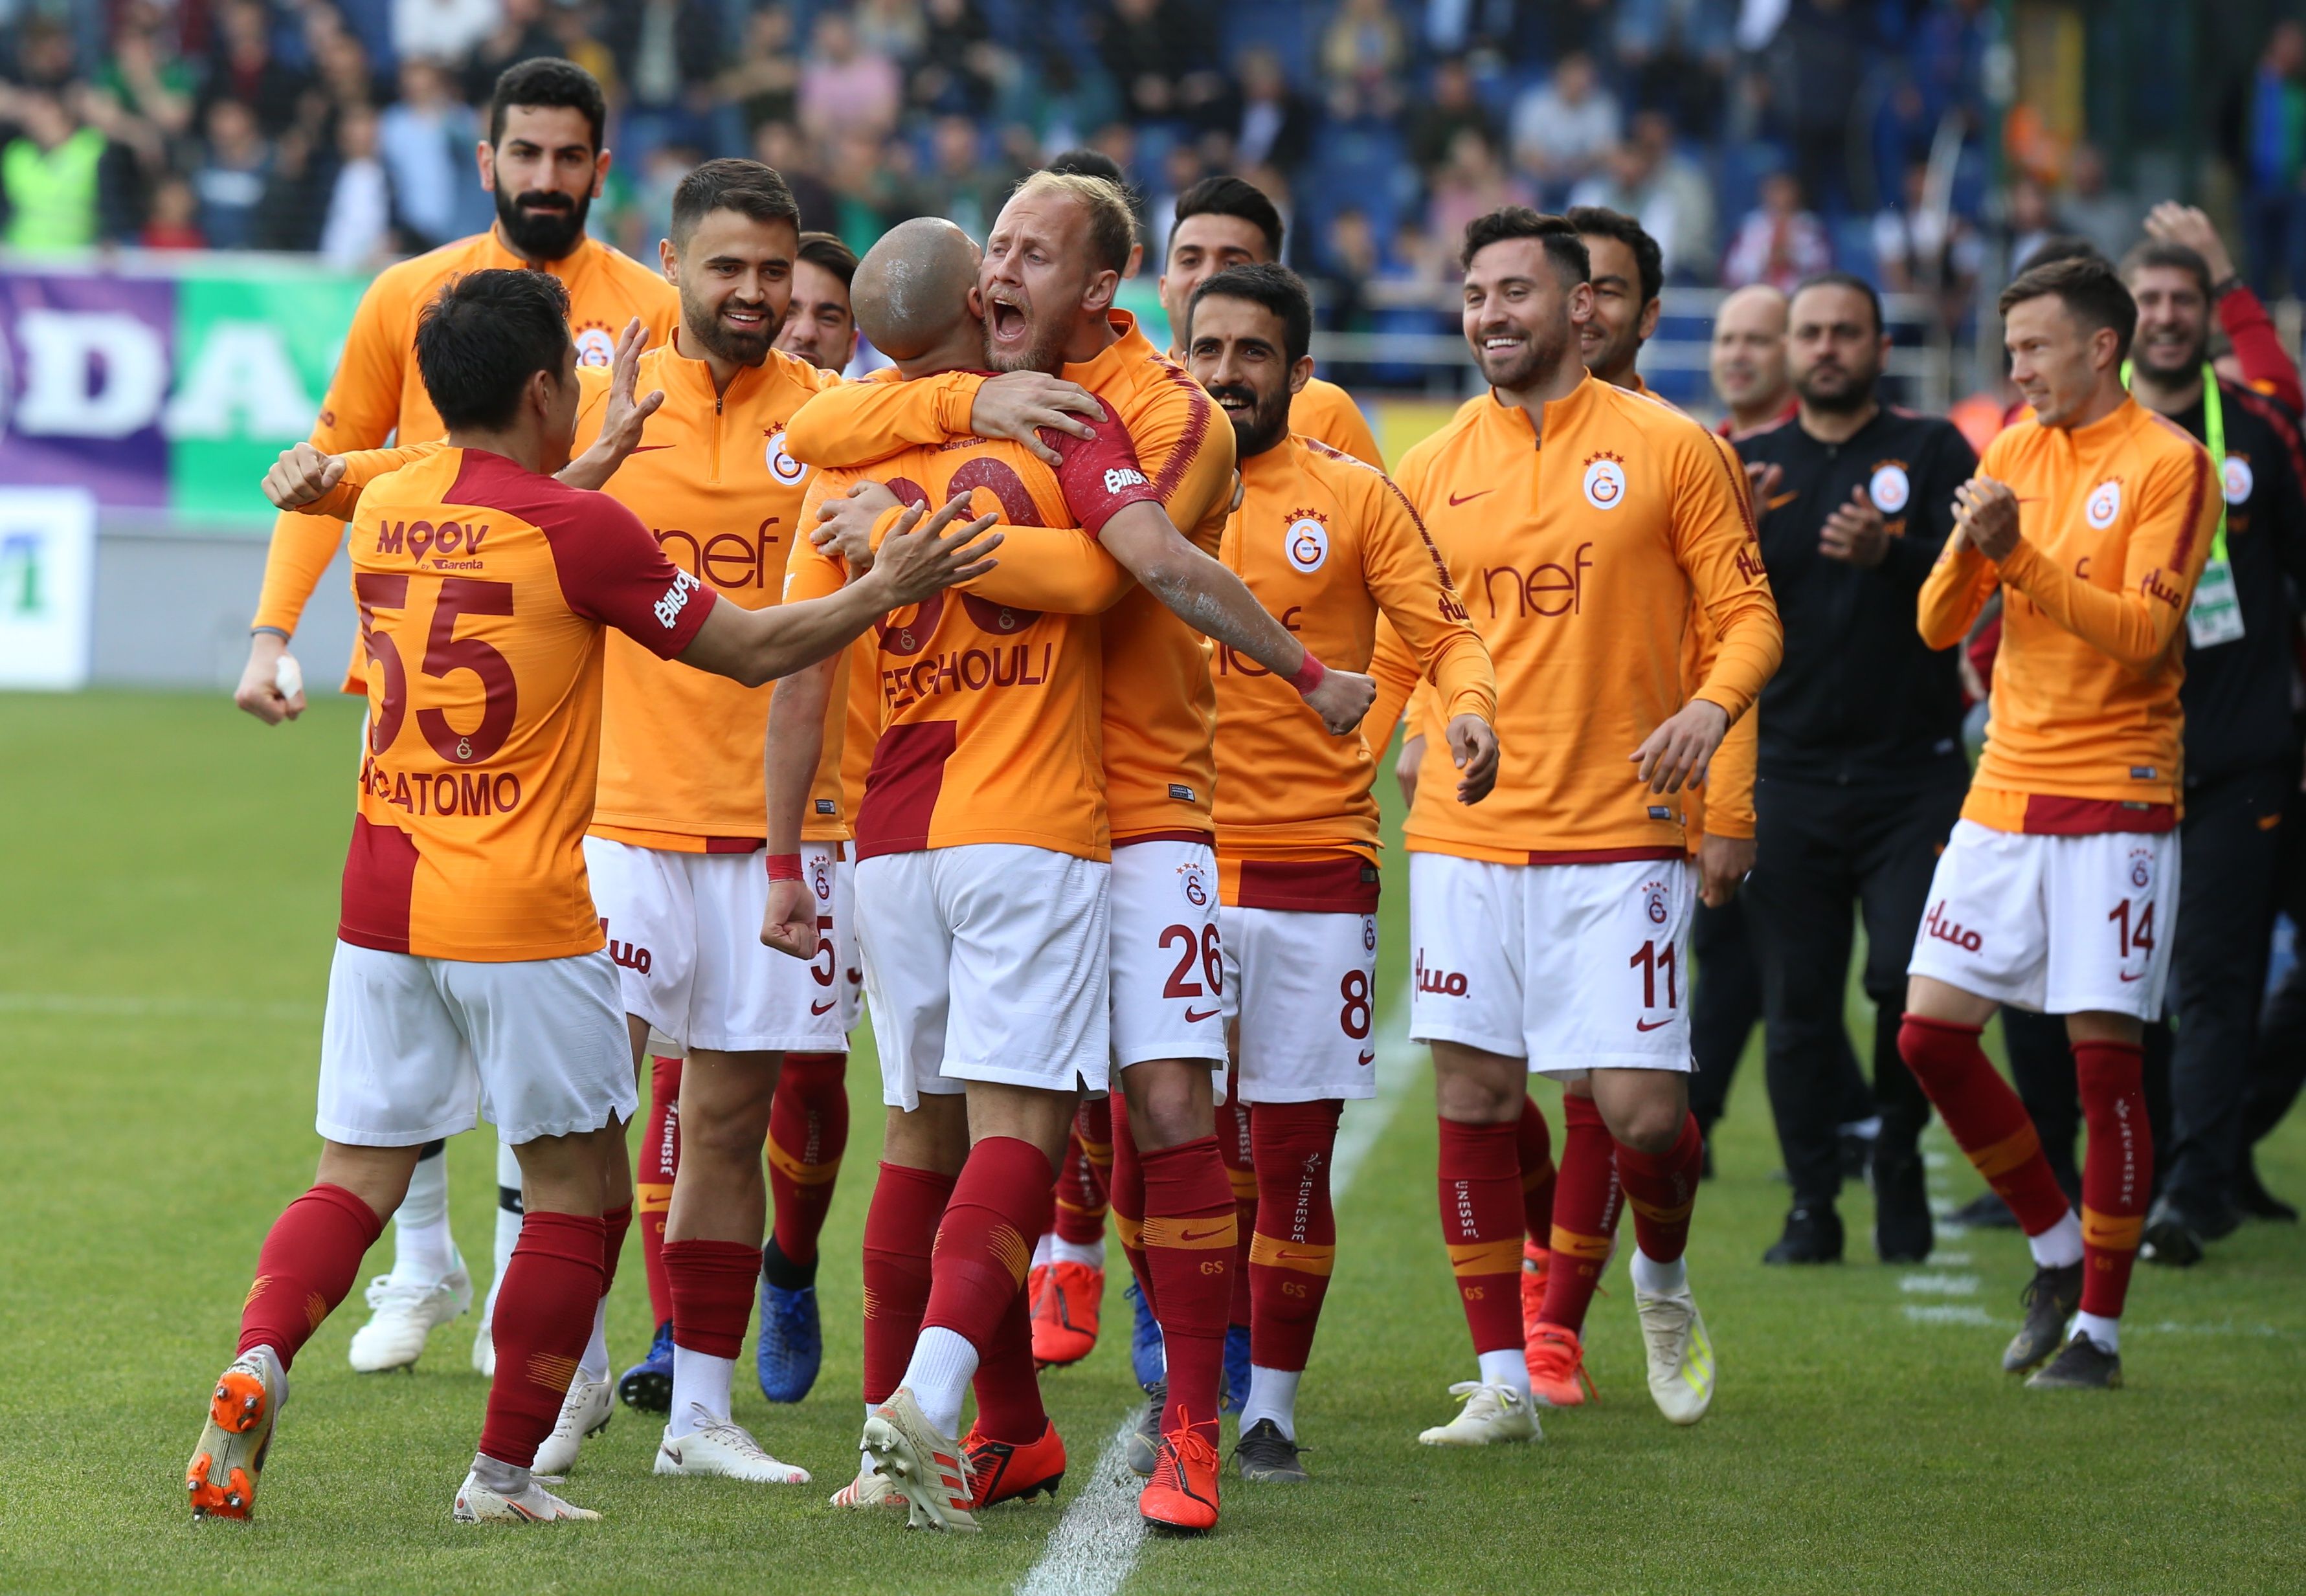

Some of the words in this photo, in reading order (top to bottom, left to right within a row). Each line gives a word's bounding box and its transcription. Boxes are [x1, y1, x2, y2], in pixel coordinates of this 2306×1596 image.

[0, 309, 333, 441] DA
[376, 520, 489, 565] MOOV
[432, 559, 484, 570] Garenta
[653, 517, 779, 588] nef
[1484, 542, 1593, 618] nef
[355, 572, 518, 764] 55
[1159, 924, 1223, 999] 26
[2109, 899, 2155, 961] 14
[1340, 970, 1375, 1040] 8
[1631, 940, 1677, 1009] 11
[660, 1113, 677, 1176] JEUNESSE
[1292, 1175, 1313, 1244] JEUNESSE
[1200, 1261, 1224, 1275] GS
[1282, 1281, 1306, 1298] GS
[1465, 1286, 1484, 1300] GS
